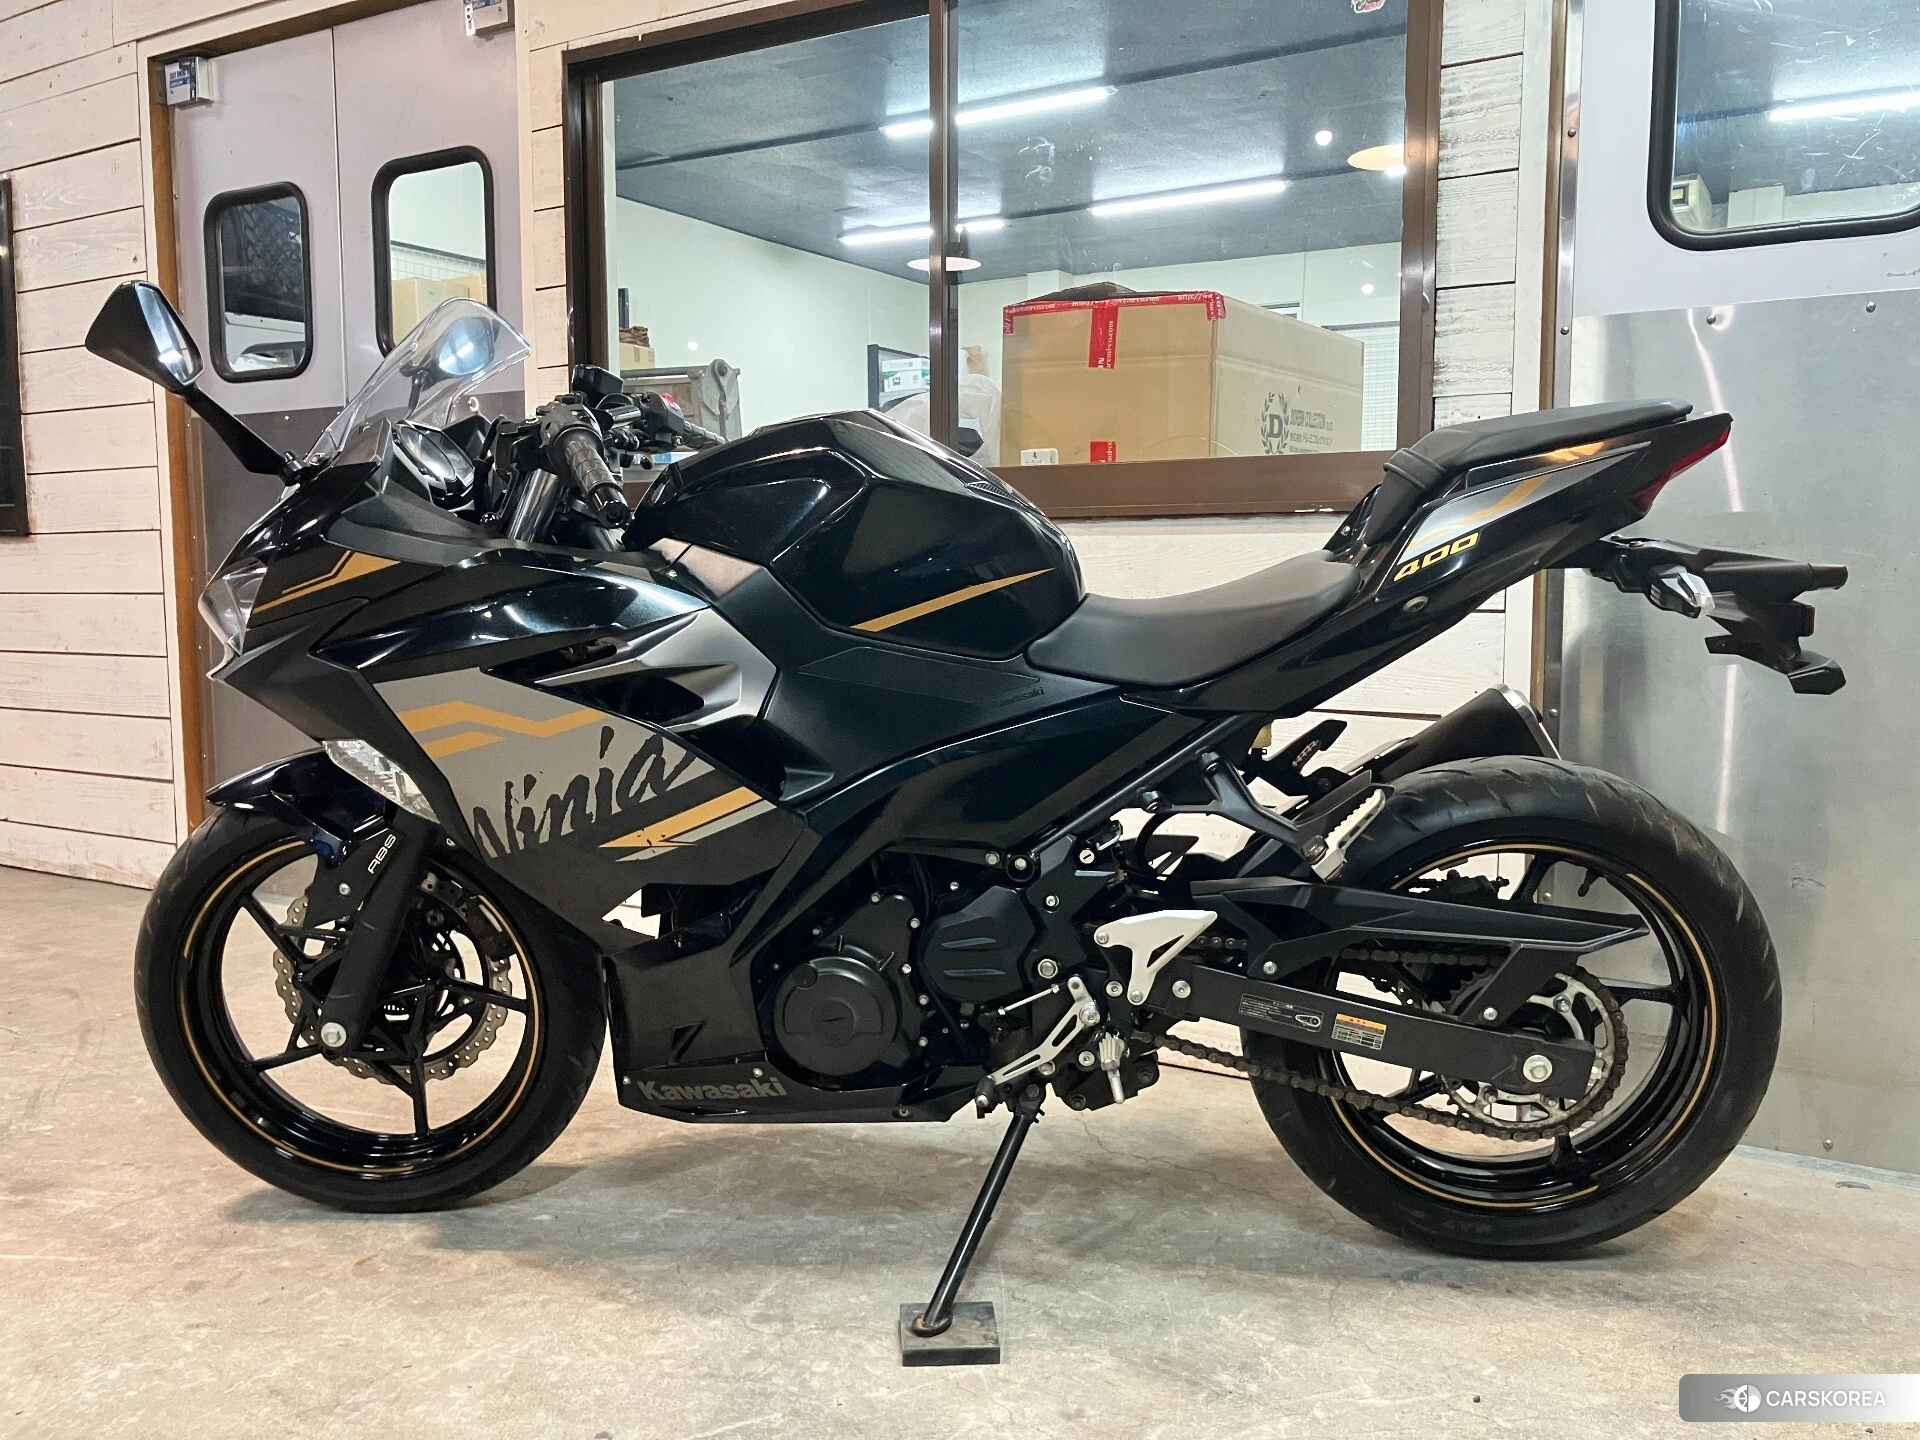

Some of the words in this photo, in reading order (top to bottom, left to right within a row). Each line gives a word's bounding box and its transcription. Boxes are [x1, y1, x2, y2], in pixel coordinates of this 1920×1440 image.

[1266, 413, 1284, 438] D
[1393, 532, 1479, 582] 400
[473, 726, 697, 858] Ninja
[367, 833, 397, 875] ABS
[637, 1076, 788, 1101] Kawasaki
